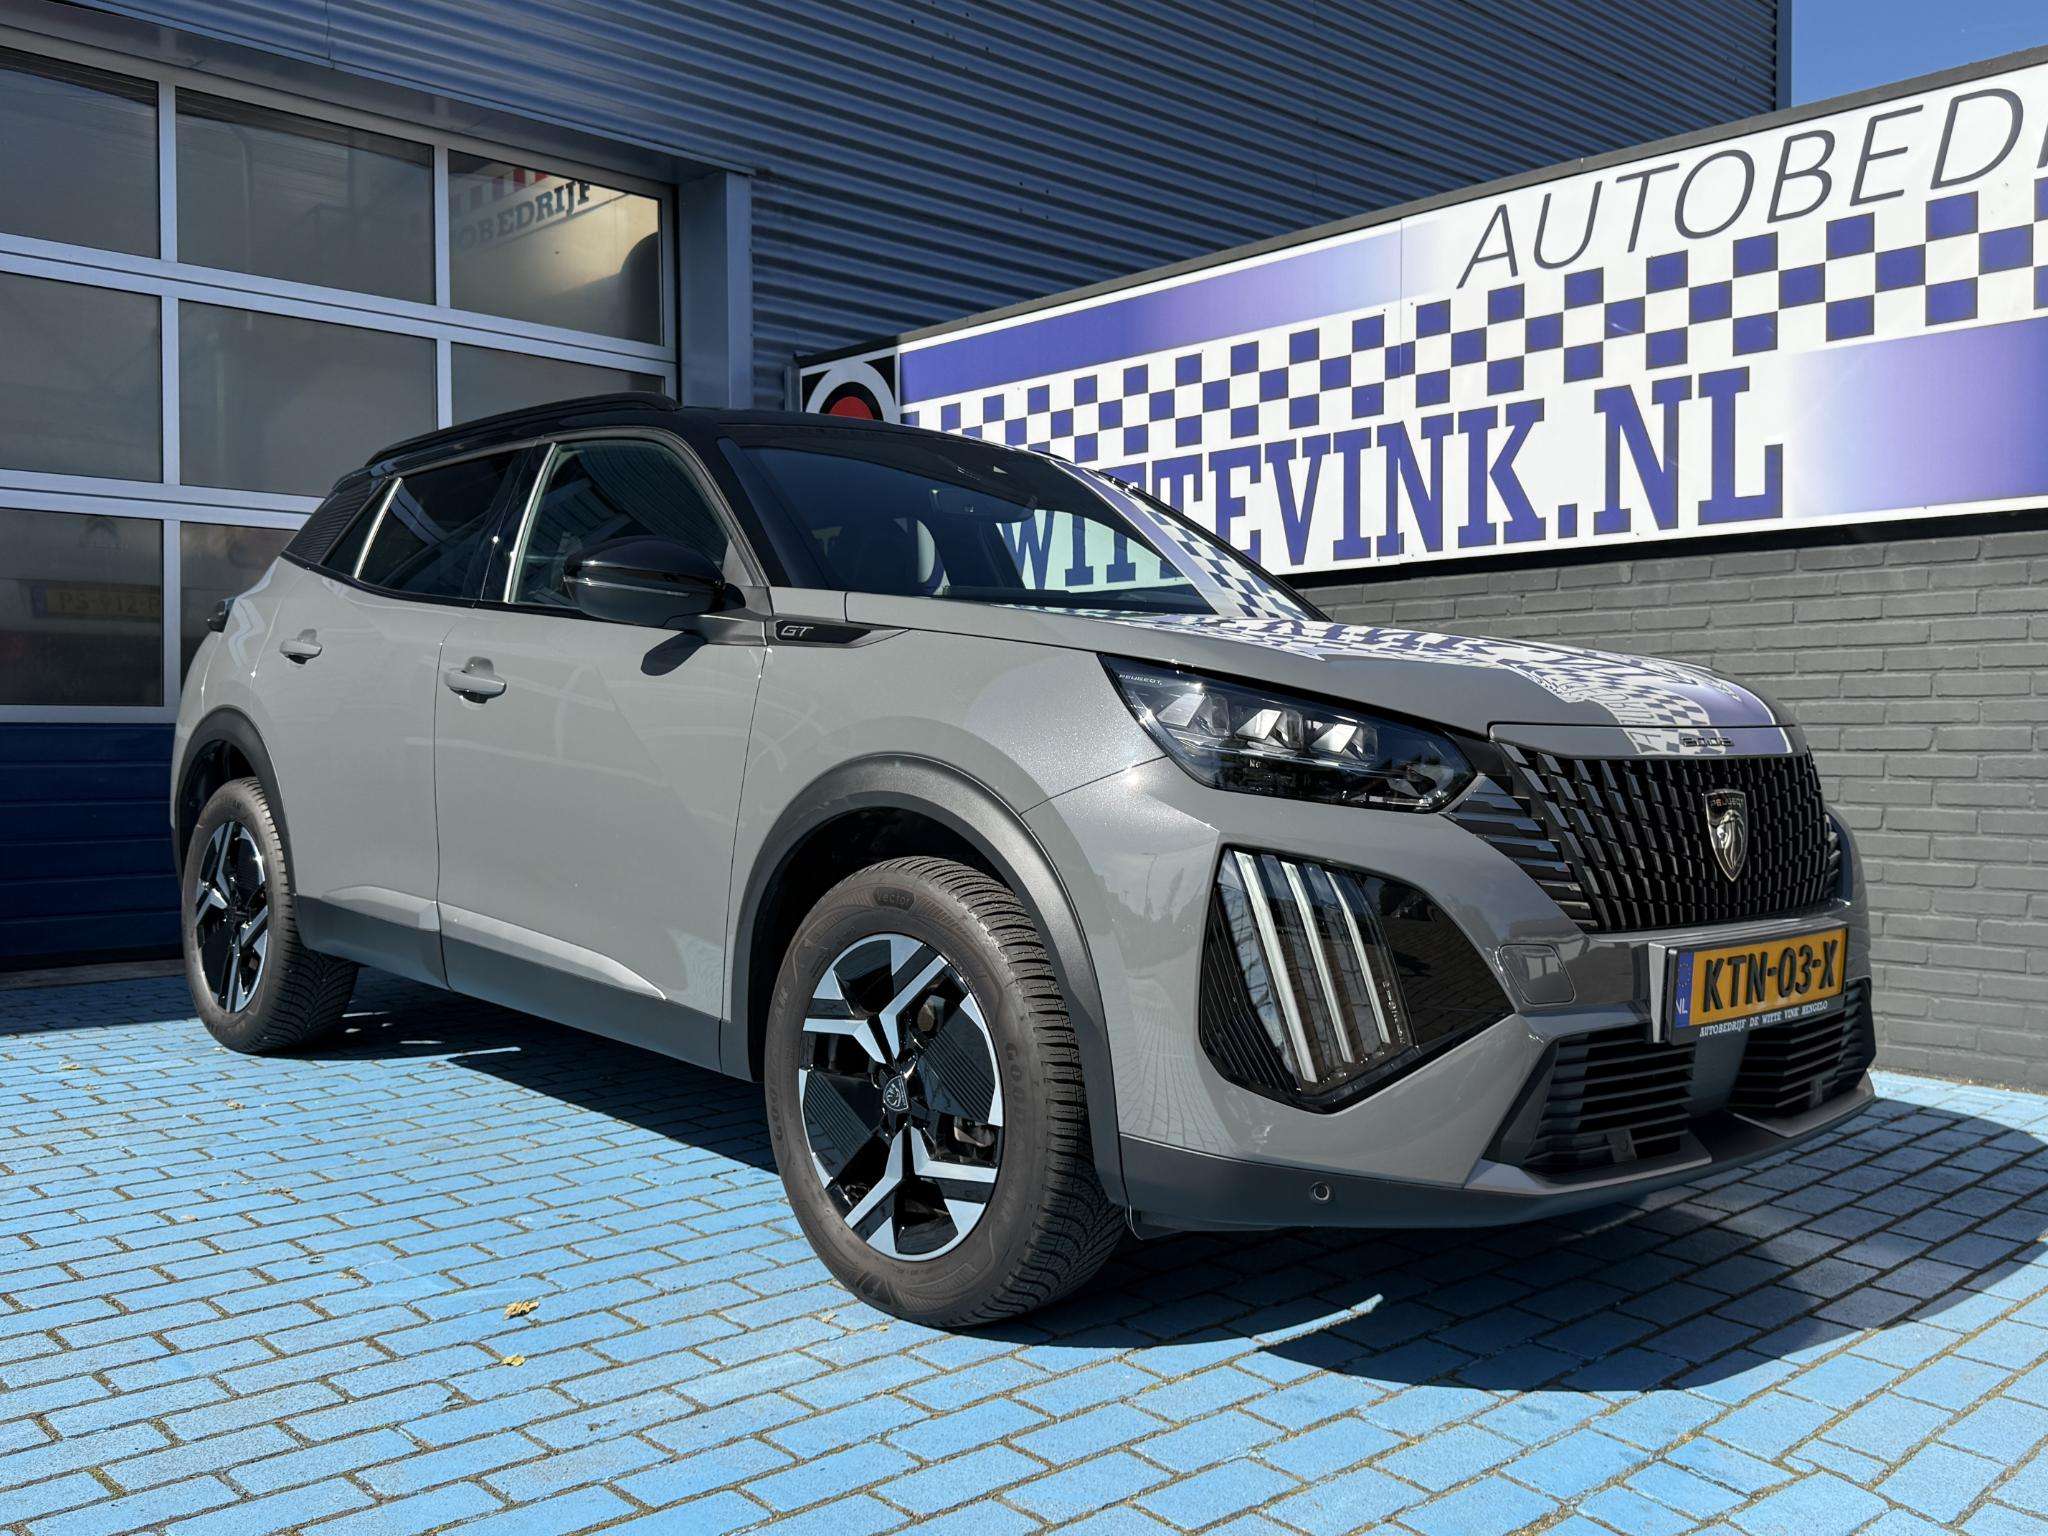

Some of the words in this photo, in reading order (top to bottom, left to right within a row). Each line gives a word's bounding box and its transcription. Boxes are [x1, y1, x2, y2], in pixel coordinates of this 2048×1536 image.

[1456, 87, 2048, 290] AUTOBED
[780, 625, 814, 638] GT
[1118, 673, 1163, 686] PEUGEOT
[1702, 939, 1838, 1012] KTN-03-X
[1675, 996, 1689, 1015] NL
[1699, 1018, 1747, 1038] AUTOBEDRIJF
[1749, 1016, 1760, 1028] DE
[1762, 1011, 1783, 1025] WITTE
[1784, 1007, 1801, 1019] VINK
[1801, 1000, 1829, 1015] HENGELO
